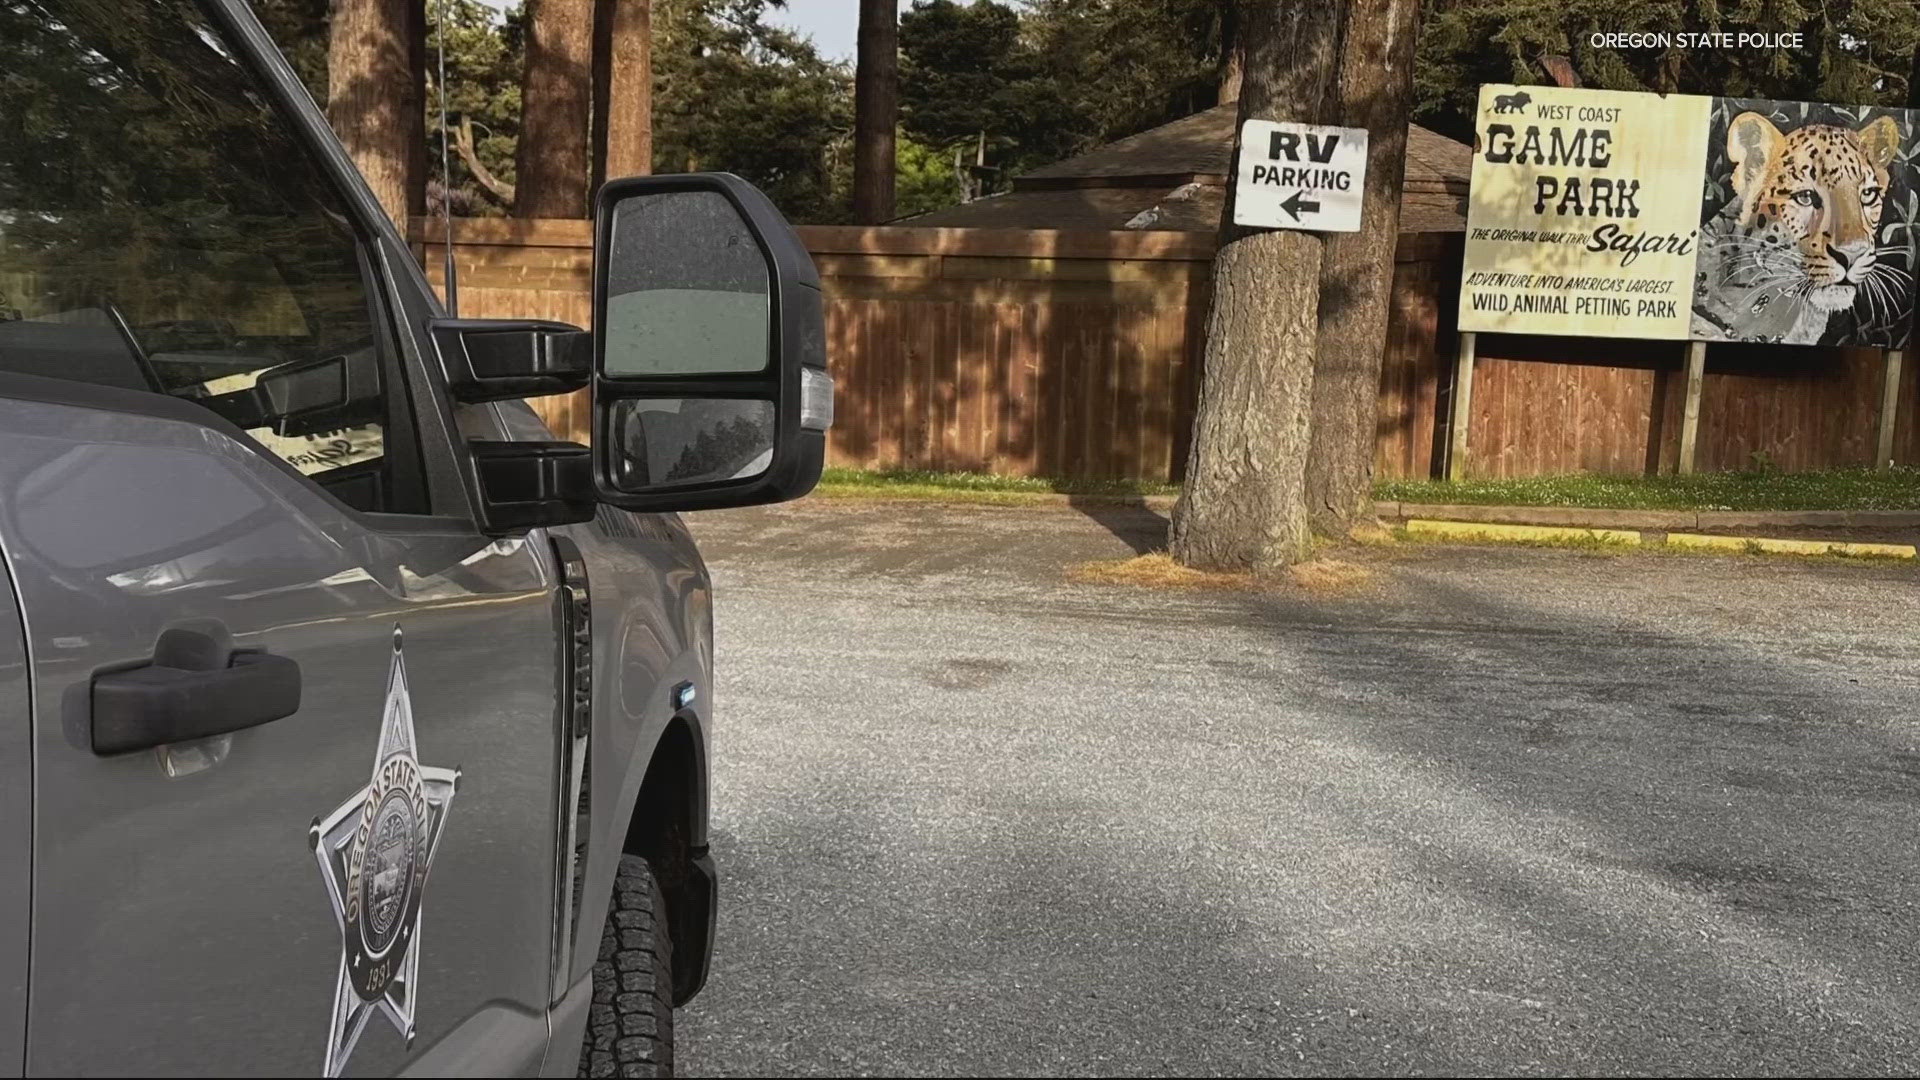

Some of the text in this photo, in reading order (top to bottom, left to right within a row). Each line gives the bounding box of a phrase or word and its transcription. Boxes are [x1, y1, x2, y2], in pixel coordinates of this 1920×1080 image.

[1537, 104, 1622, 124] WEST COAST
[1269, 130, 1340, 164] RV
[1484, 123, 1613, 168] GAME
[1252, 165, 1351, 191] PARKING
[1534, 175, 1641, 218] PARK
[1470, 223, 1697, 267] THE ORIGINAL WALK THRU Safari
[1465, 272, 1674, 294] ADVENTURE INTO AMERICA'S LARGEST
[1513, 295, 1569, 314] ANIMAL
[1575, 297, 1631, 316] PETTING
[1637, 300, 1677, 318] PARK
[348, 779, 382, 923] OREGON
[383, 759, 416, 793] STATE
